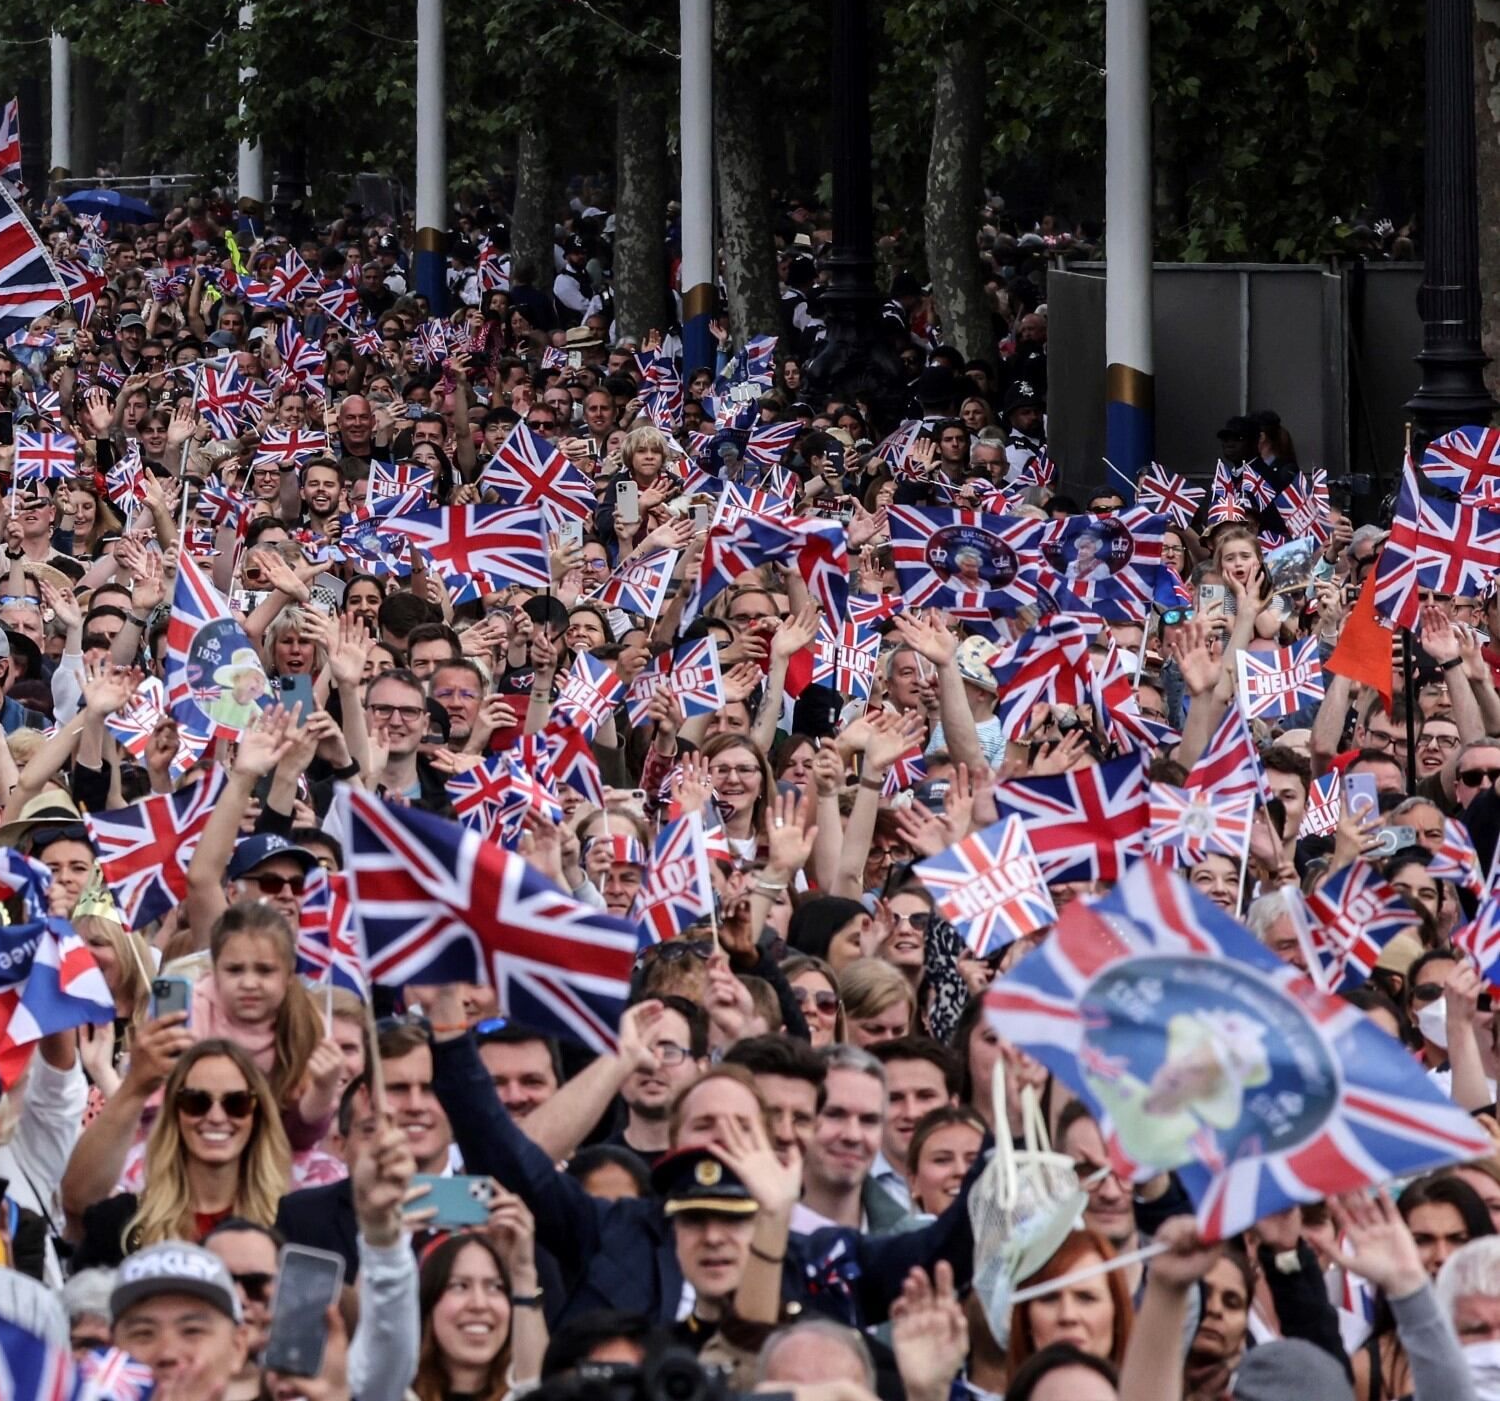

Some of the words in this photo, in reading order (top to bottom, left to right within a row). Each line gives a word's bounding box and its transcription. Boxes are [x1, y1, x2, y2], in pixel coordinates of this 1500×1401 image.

[197, 647, 223, 668] 1952
[1255, 662, 1314, 696] HELLO!
[961, 857, 1040, 919] HELLO!
[123, 1248, 223, 1282] OAKLEY
